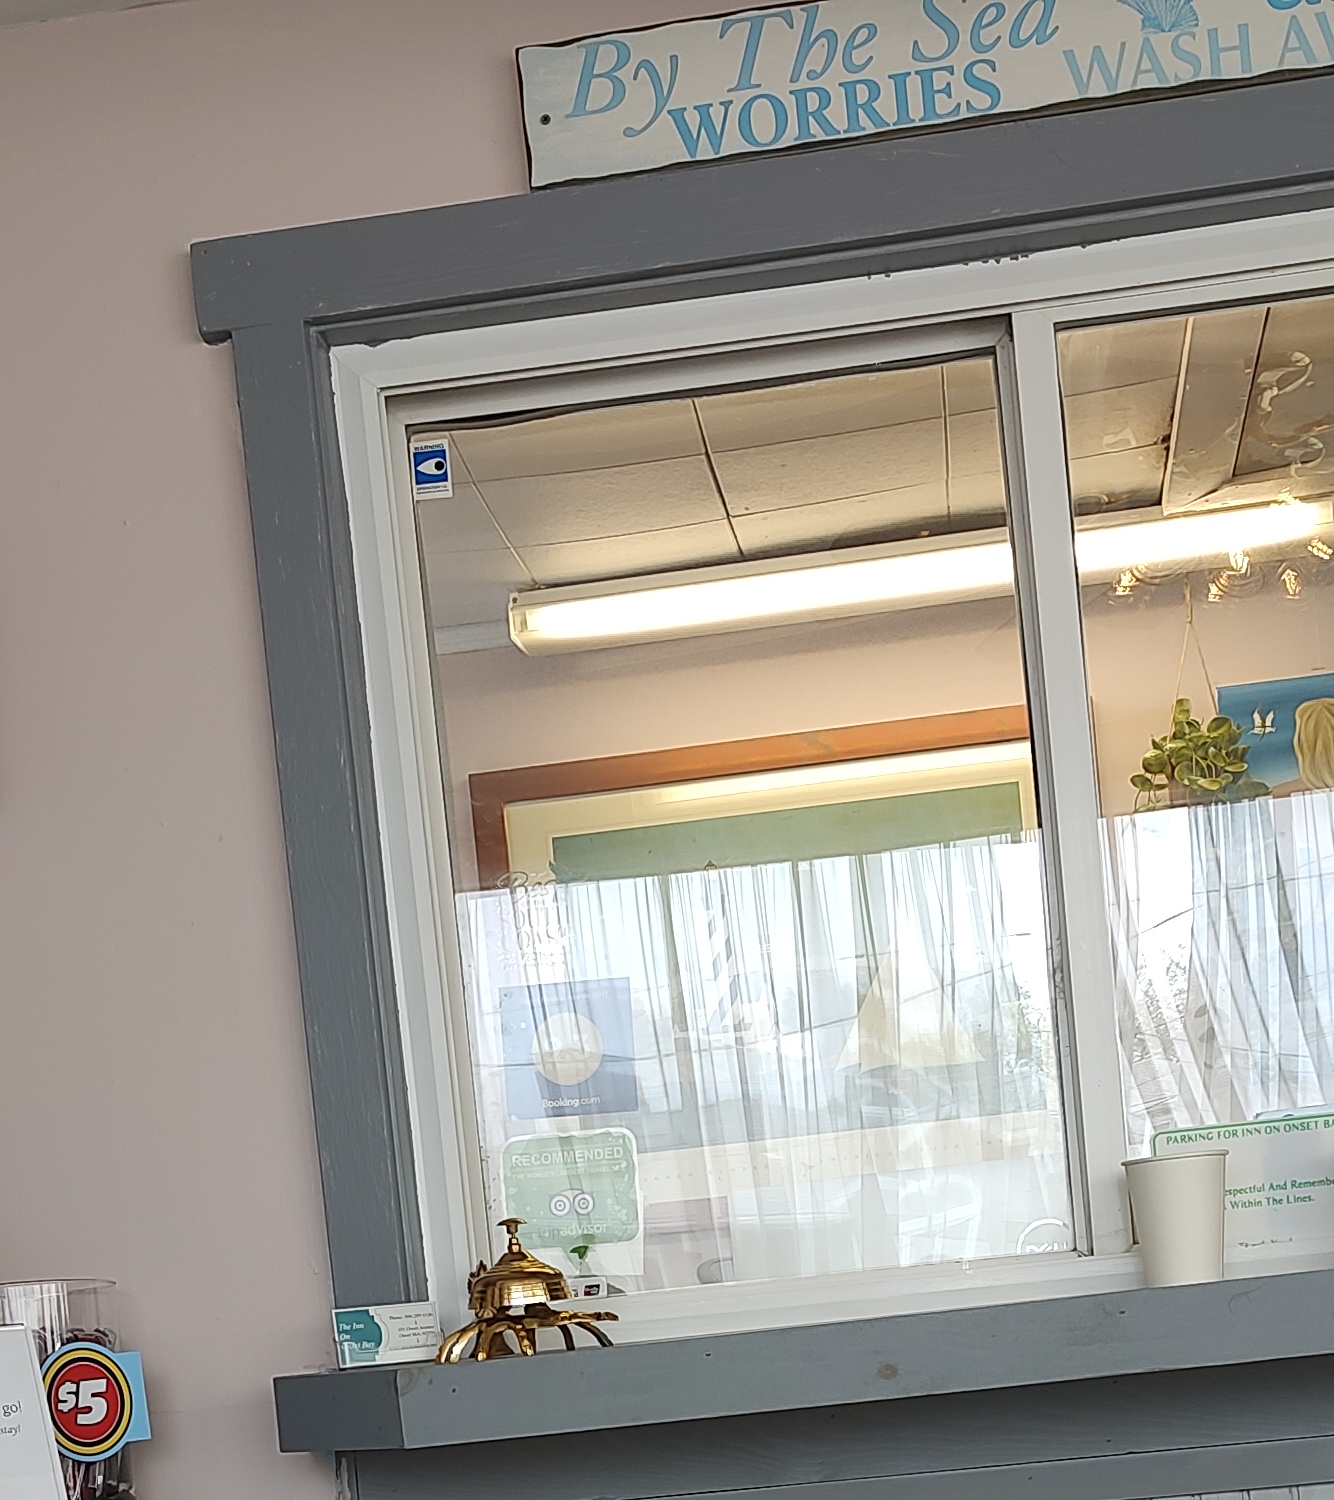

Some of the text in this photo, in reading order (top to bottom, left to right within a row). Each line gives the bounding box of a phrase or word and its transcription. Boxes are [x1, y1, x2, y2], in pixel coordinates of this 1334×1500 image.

[1062, 22, 1254, 96] WASH
[564, 0, 1060, 138] By The Sea
[667, 58, 1002, 159] WORRIES
[542, 1096, 601, 1109] Booking.com
[1166, 1131, 1213, 1145] PARKING
[1217, 1129, 1239, 1139] FOR
[1242, 1127, 1262, 1138] INN
[1264, 1125, 1280, 1135] ON
[1283, 1120, 1320, 1133] ONSET
[512, 1147, 623, 1167] RECOMMENDED
[1224, 1183, 1265, 1197] spectful
[1268, 1180, 1287, 1192] And
[1230, 1200, 1262, 1210] Within
[1265, 1196, 1284, 1206] The
[1286, 1193, 1315, 1204] Lines.
[538, 1222, 607, 1240] tripadvisor
[2, 1401, 23, 1417] go!
[57, 1378, 108, 1425] $5
[0, 1424, 21, 1437] stay!
